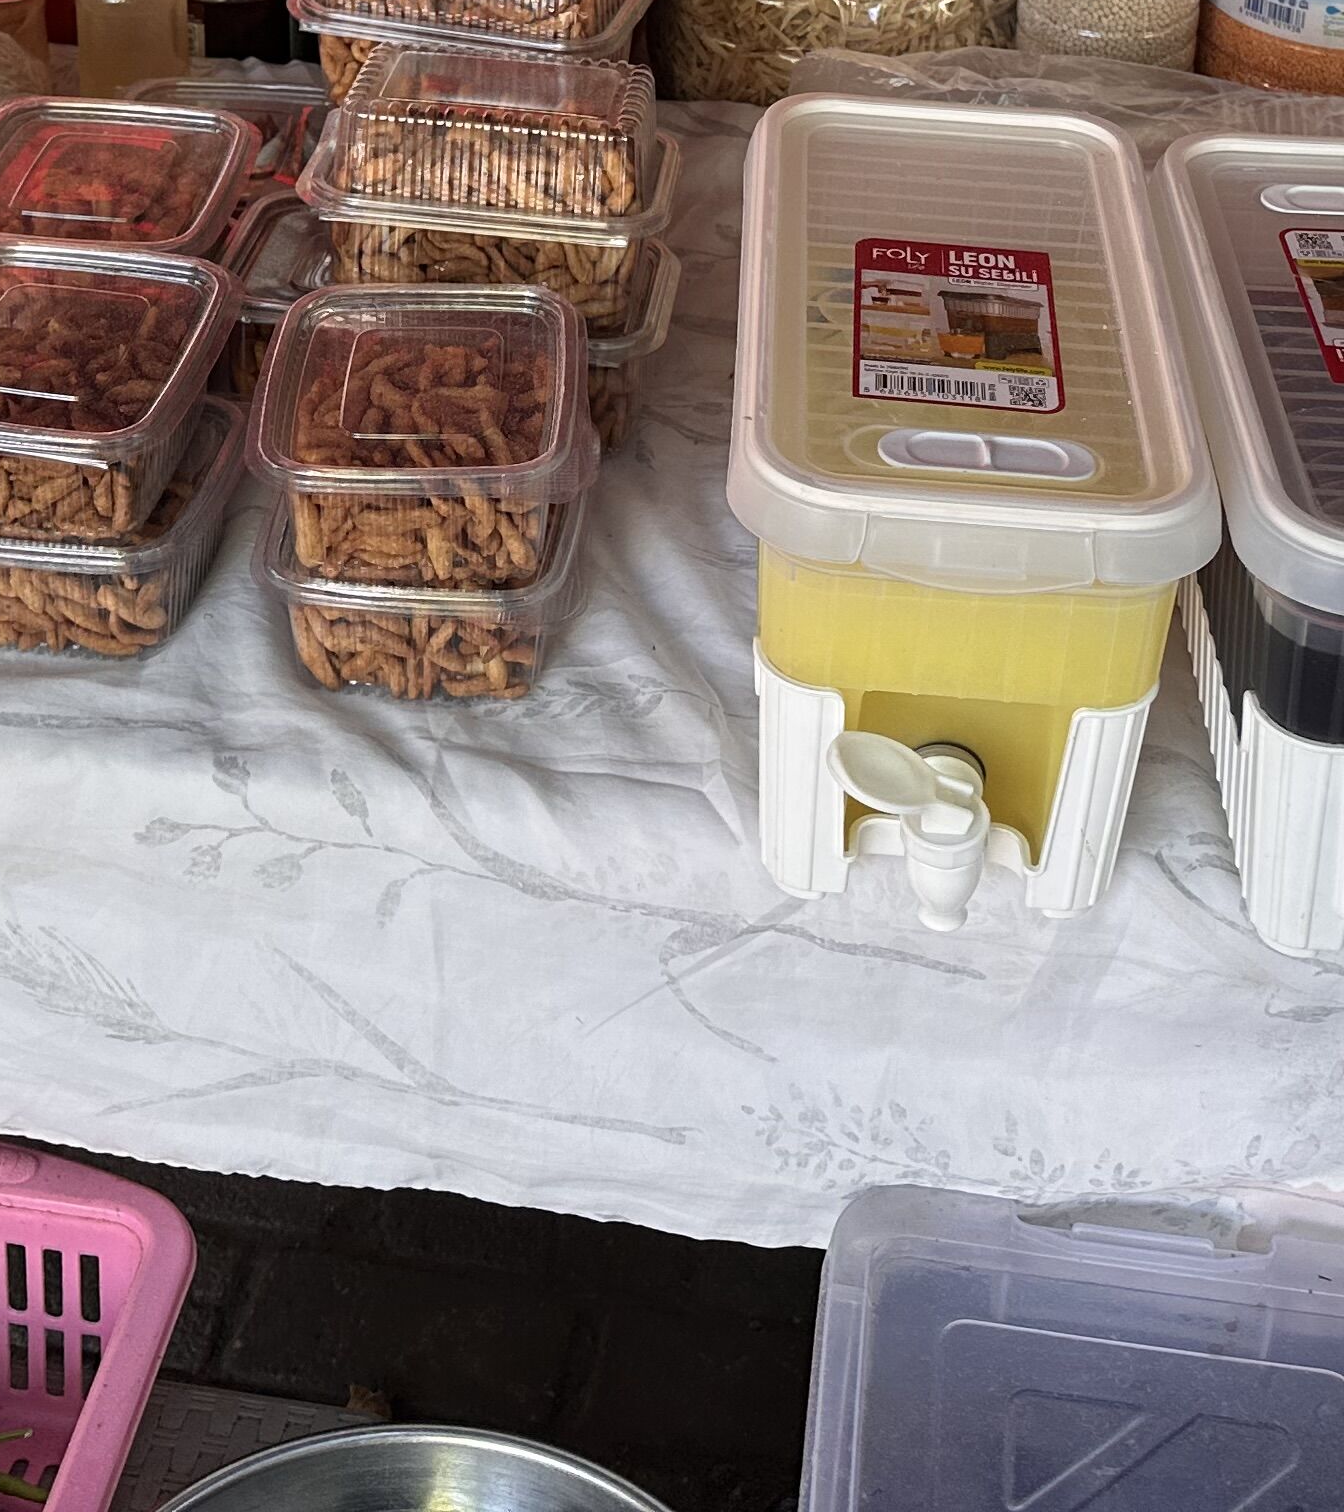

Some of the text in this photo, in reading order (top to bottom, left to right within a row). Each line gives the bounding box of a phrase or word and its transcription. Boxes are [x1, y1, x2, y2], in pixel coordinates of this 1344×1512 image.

[871, 246, 931, 265] FOLY
[948, 250, 1016, 269] LEON
[948, 265, 974, 278] SU
